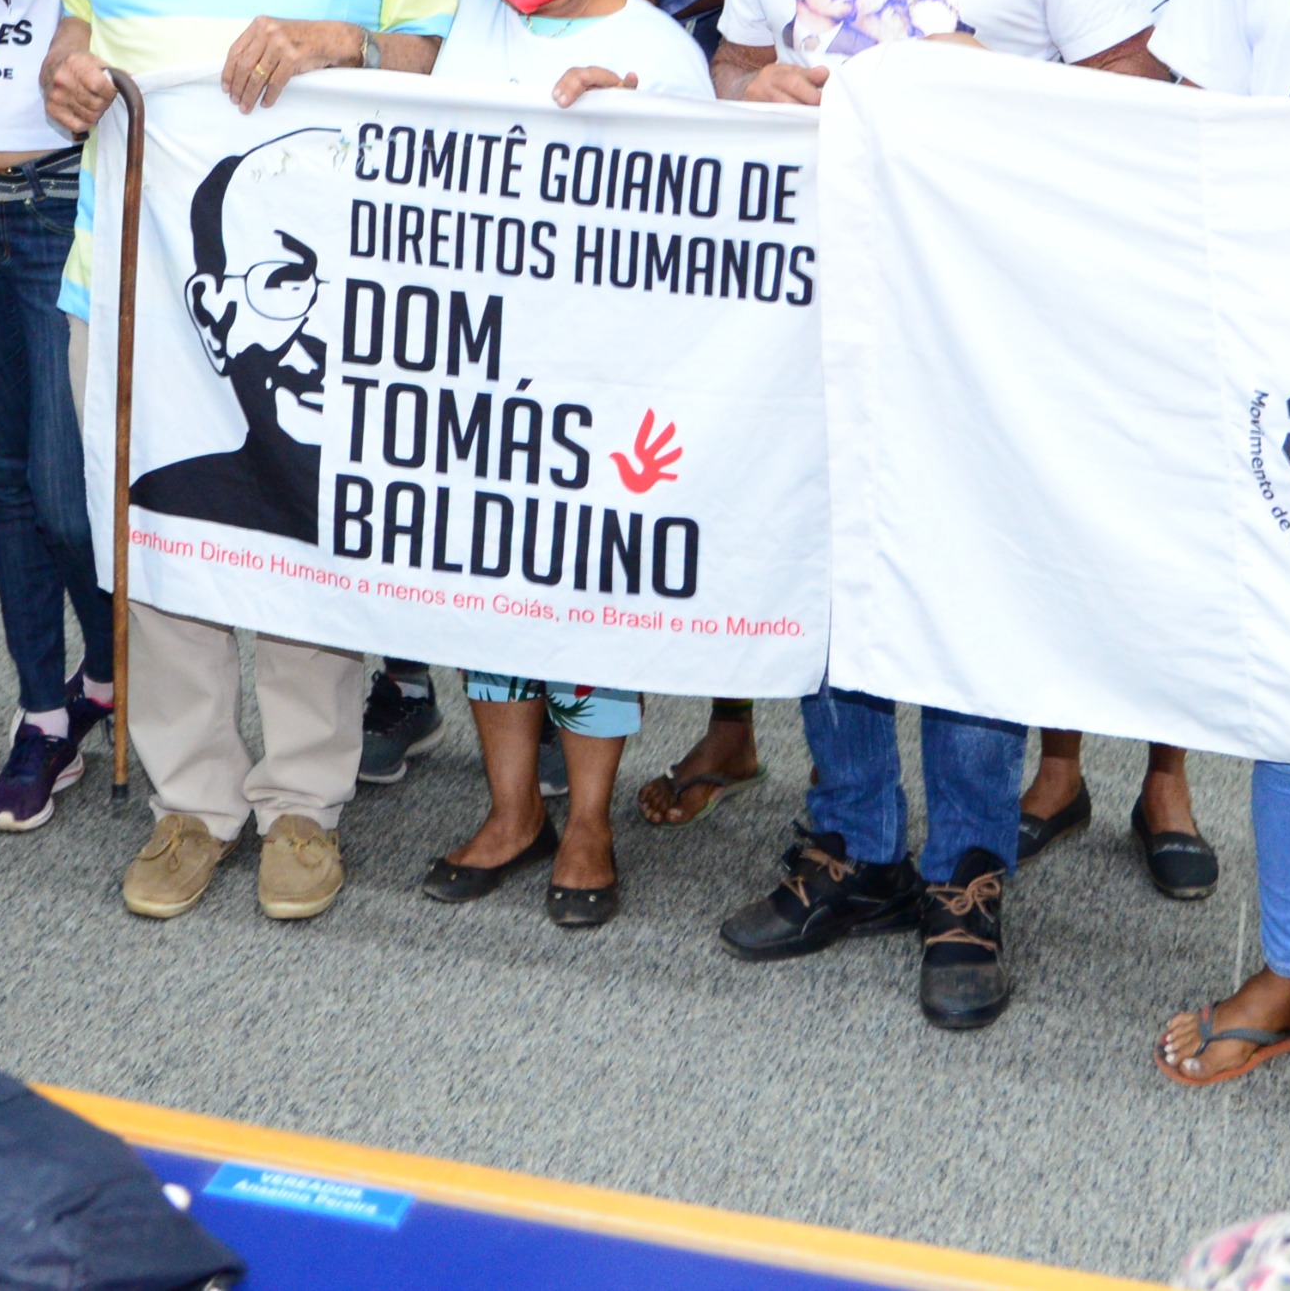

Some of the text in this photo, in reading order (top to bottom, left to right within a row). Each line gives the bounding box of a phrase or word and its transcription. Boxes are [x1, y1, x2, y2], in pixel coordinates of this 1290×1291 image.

[355, 123, 801, 225] COMITÊ GOIANO DE
[350, 199, 816, 307] DIREITOS HUMANOS
[342, 278, 504, 380] DOM
[343, 376, 594, 490] TOMÁS
[1249, 390, 1275, 500] Movimento
[200, 540, 264, 570] Direito
[270, 556, 351, 591] Humano
[357, 578, 370, 593] a
[377, 583, 446, 606] menos
[453, 592, 485, 610] em
[492, 594, 559, 624] Goiás,
[568, 607, 594, 623] no
[602, 606, 663, 631] Brasil
[671, 618, 683, 632] e
[691, 619, 718, 634] no
[726, 615, 806, 637] Mundo.
[333, 473, 701, 599] BALDUINO
